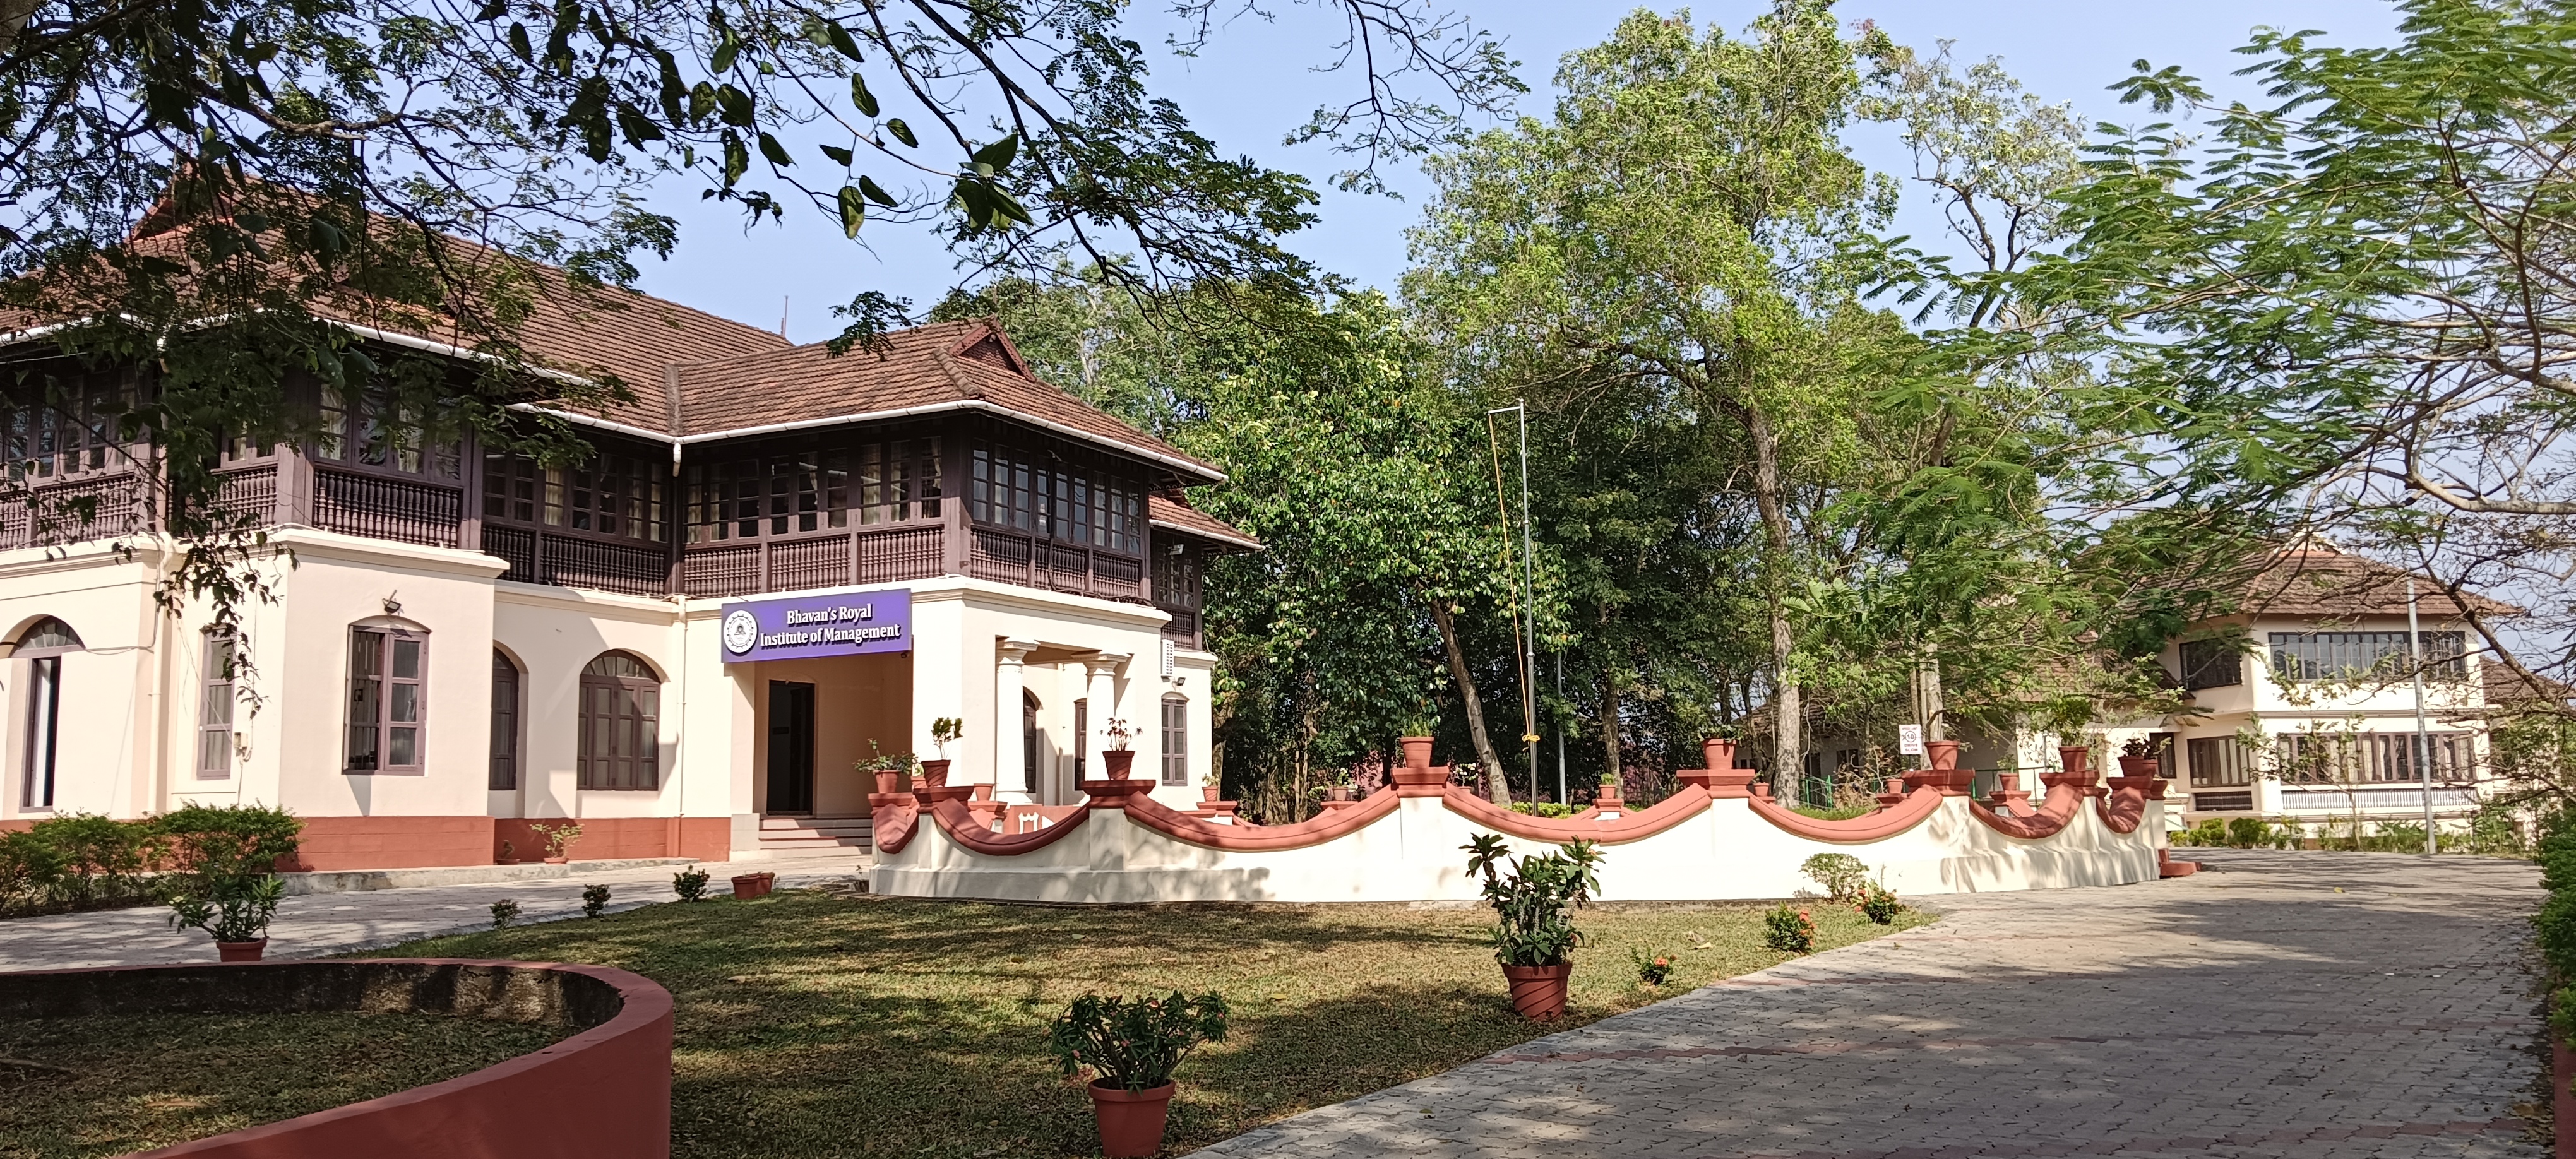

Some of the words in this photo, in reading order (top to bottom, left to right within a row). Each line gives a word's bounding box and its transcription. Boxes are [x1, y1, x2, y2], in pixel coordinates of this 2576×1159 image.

[787, 607, 837, 624] Bhavan's
[839, 603, 872, 622] Royal
[760, 631, 808, 646] Institute
[810, 627, 823, 643] of
[823, 624, 900, 643] Management
